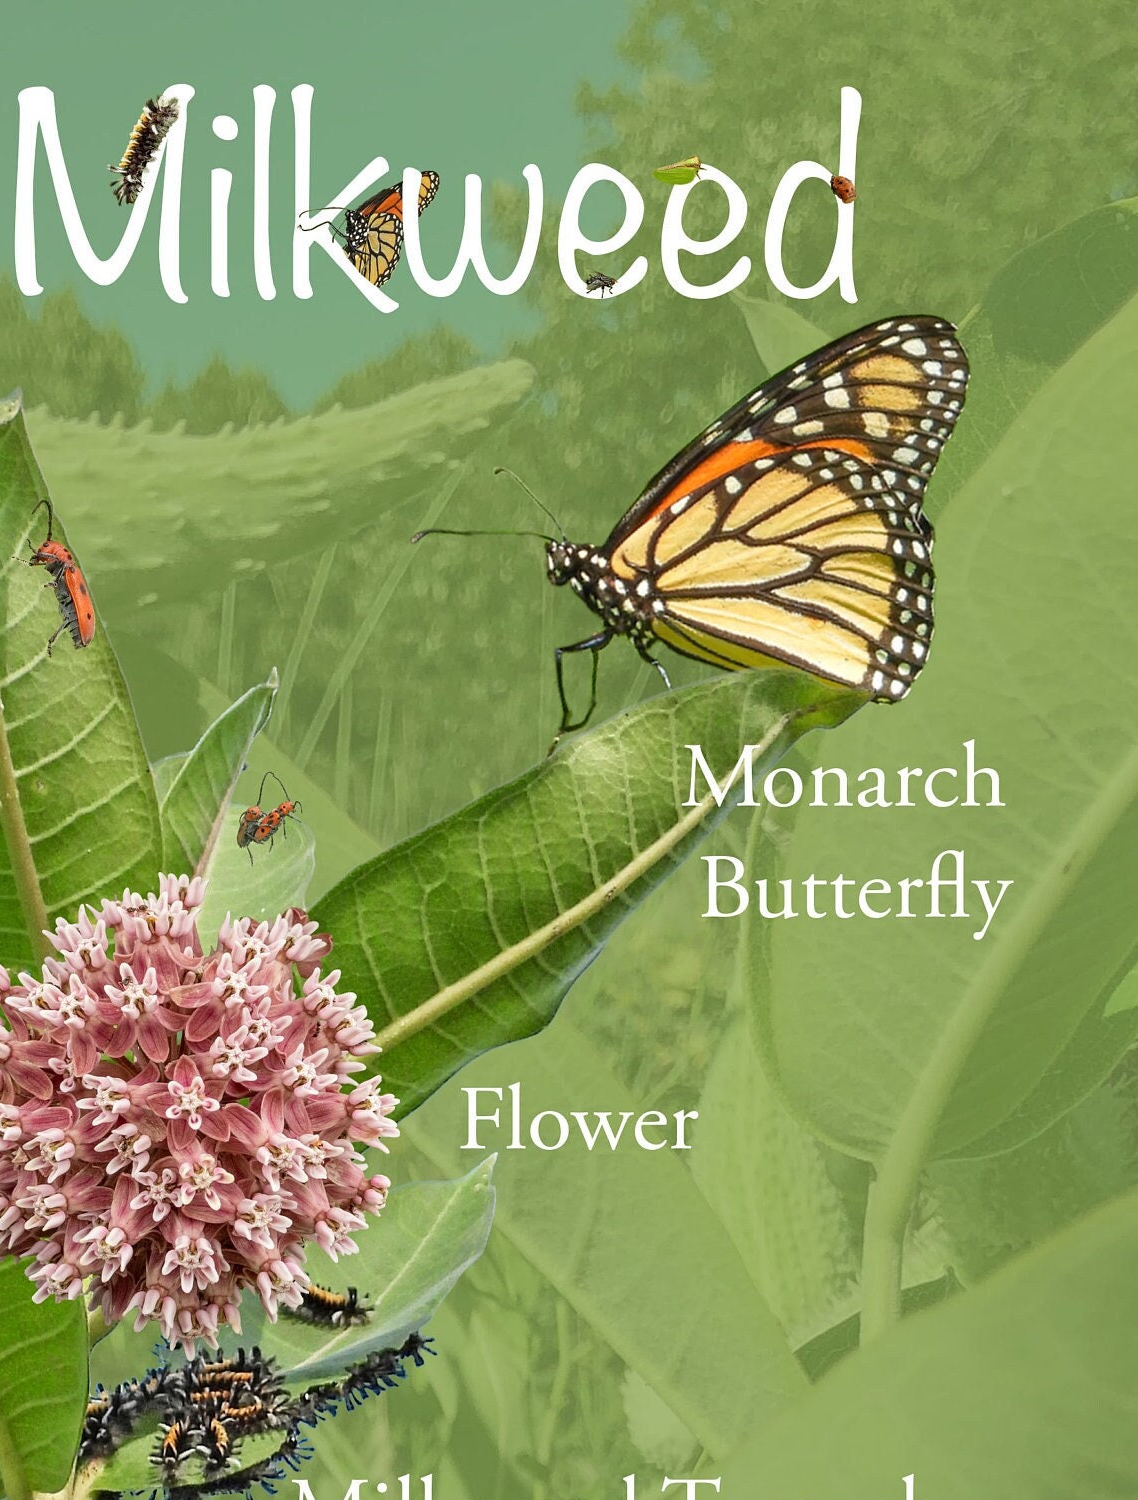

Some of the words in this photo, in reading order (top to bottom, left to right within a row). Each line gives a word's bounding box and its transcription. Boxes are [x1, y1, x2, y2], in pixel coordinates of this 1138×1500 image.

[14, 83, 862, 314] Milkweed
[681, 739, 1006, 808] Monarch
[700, 849, 1014, 941] Butterfly
[460, 1082, 699, 1151] Flower
